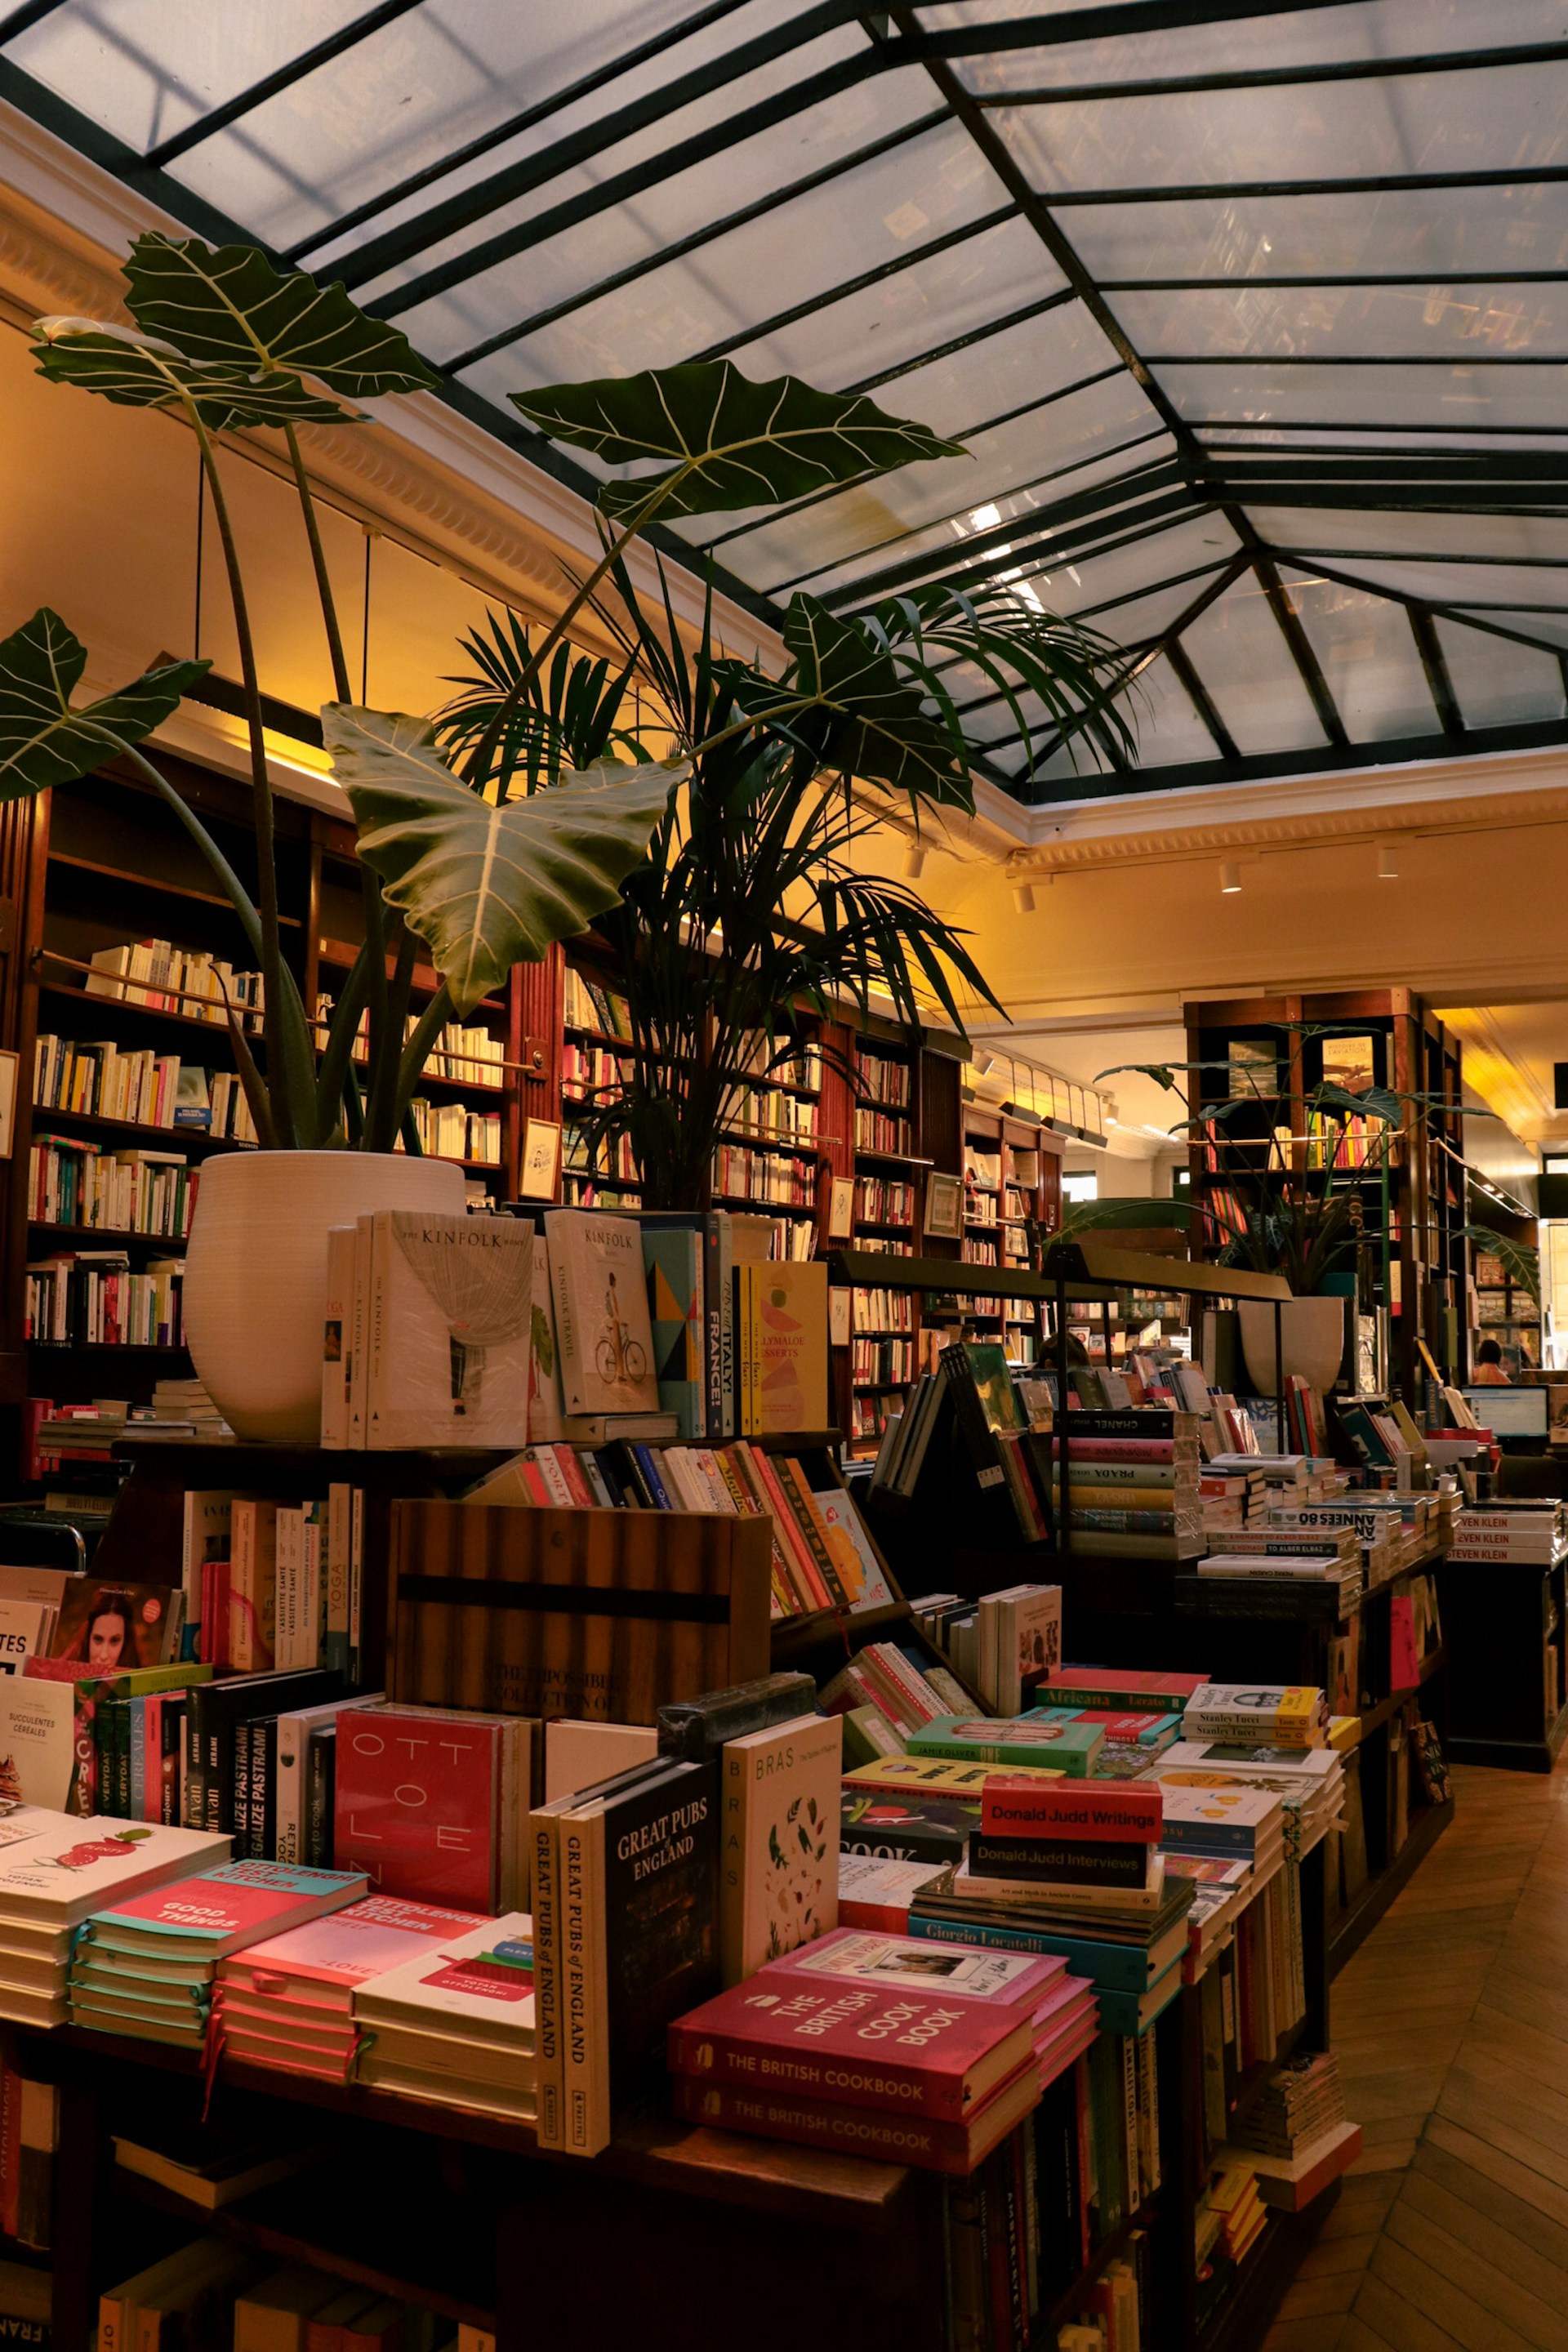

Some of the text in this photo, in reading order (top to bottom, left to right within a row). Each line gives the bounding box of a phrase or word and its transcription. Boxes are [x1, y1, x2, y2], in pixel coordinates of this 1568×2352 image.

[422, 1229, 501, 1248] KINFOLK
[585, 1229, 632, 1249] KINFOLK
[558, 1266, 574, 1357] KINFOLK TRAVEL
[710, 1311, 721, 1406] FRANCE!
[723, 1333, 733, 1393] ITALY!
[1094, 1419, 1138, 1429] CHANEL
[1094, 1469, 1134, 1478] PRADA
[1299, 1513, 1317, 1525] 80
[1482, 1517, 1508, 1527] KLEIN
[1483, 1534, 1509, 1544] KLEIN
[1446, 1549, 1508, 1559] STEVEN KLEIN
[331, 1564, 342, 1613] YOGA
[1046, 1690, 1111, 1707] Africana
[9, 1713, 56, 1728] SUCCULENTES
[13, 1723, 47, 1737] CÉRÉALES
[1196, 1726, 1230, 1736] Stanley
[1232, 1727, 1256, 1737] Tucci
[1200, 1714, 1232, 1726] Stanley
[1236, 1714, 1259, 1724] Tucci
[210, 1735, 218, 1768] AKRAME
[234, 1725, 248, 1800] PASTRAMI
[944, 1748, 976, 1757] OLIVER
[980, 1746, 1000, 1764] ONE
[252, 1727, 266, 1802] PASTRAMI
[755, 1747, 794, 1780] BRAS
[103, 1750, 111, 1809] EVERYDAY
[119, 1753, 128, 1811] EVERYDAY
[312, 1798, 321, 1829] cook
[727, 1761, 741, 1886] BRAS
[991, 1806, 1155, 1829] Donald Judd Writings
[617, 1797, 708, 1861] GREAT PUBS
[83, 1844, 125, 1854] PLENTY
[634, 1835, 694, 1882] ENGLAND
[977, 1846, 1138, 1871] Donald Judd Interviews
[212, 1871, 299, 1889] KITCHEN
[229, 1867, 278, 1878] TEST
[238, 1862, 359, 1882] OTTOLENGHI
[156, 1910, 240, 1927] THINGS
[163, 1902, 226, 1917] GOOD
[341, 1909, 435, 1931] KITCHEN
[358, 1903, 411, 1917] TEST
[537, 1833, 555, 2059] GREAT PUBS of ENGLAND
[925, 1924, 1043, 1952] Giorgio Locatelli
[568, 1837, 584, 2064] GREAT PUBS of ENGLAND
[441, 1980, 508, 1996] OTTOLENGHI
[463, 1979, 498, 1990] YOTAM
[770, 1994, 826, 2017] THE
[793, 1990, 880, 2036] BRITISH
[857, 2002, 929, 2040] COOK
[894, 2008, 967, 2047] BOOK
[726, 2052, 924, 2100] THE BRITISH COOKBOOK
[734, 2100, 932, 2153] THE BRITISH COOKBOOK
